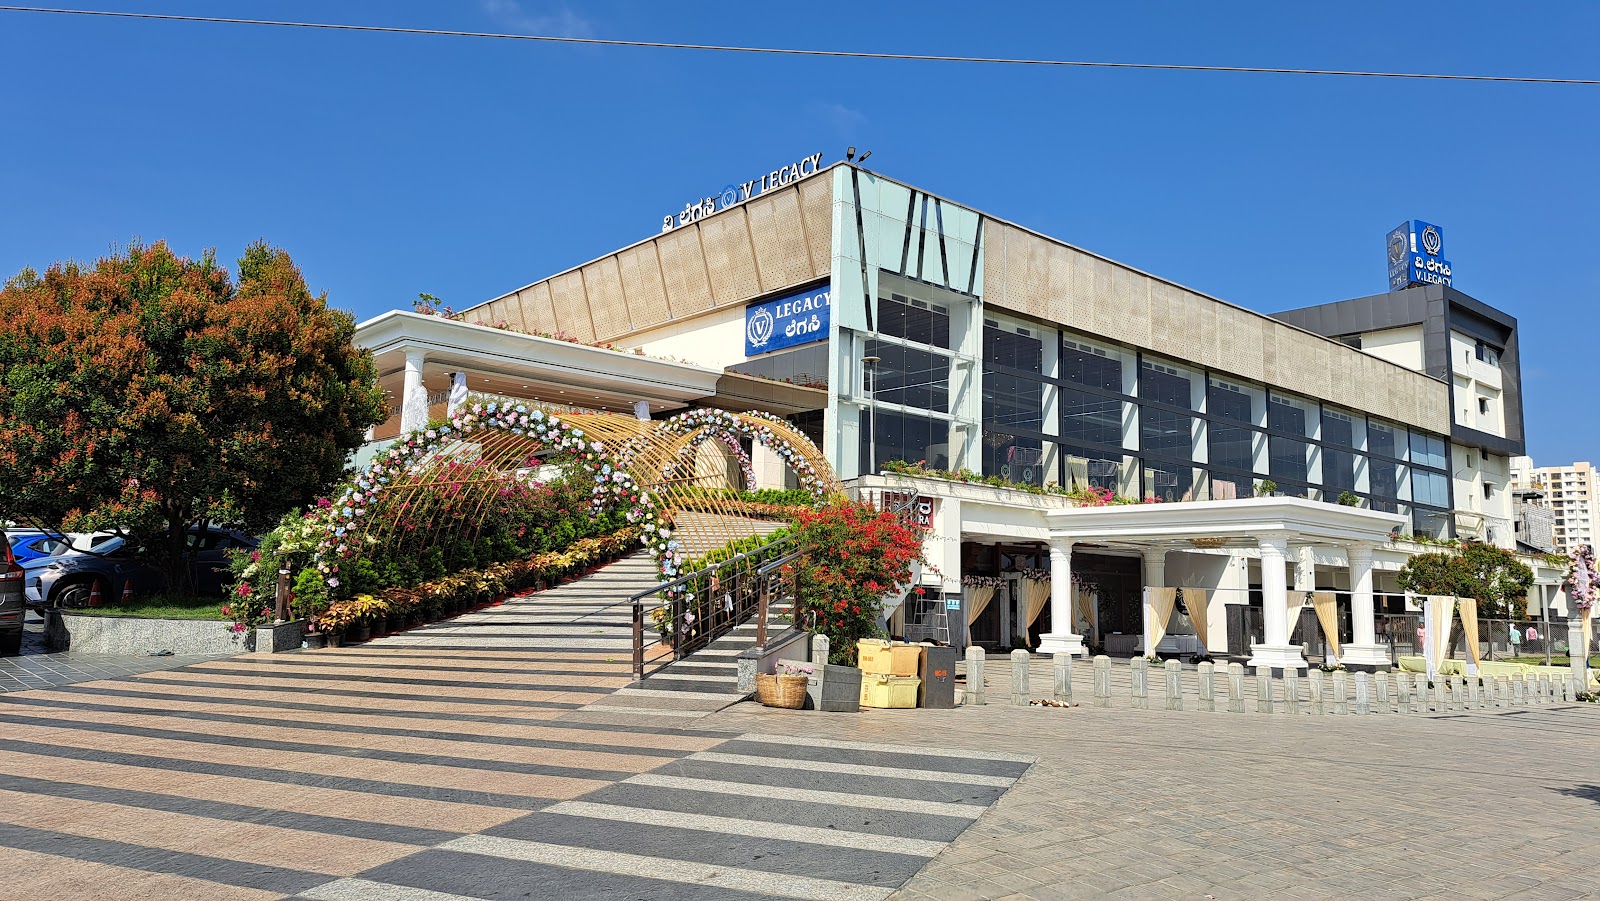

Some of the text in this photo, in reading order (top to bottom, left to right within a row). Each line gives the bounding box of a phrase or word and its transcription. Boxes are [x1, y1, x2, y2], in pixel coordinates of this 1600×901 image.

[742, 152, 823, 199] V LEGACY
[775, 291, 831, 319] LEGACY
[755, 320, 766, 335] V
[785, 314, 821, 337] ಲೆಗಸಿ
